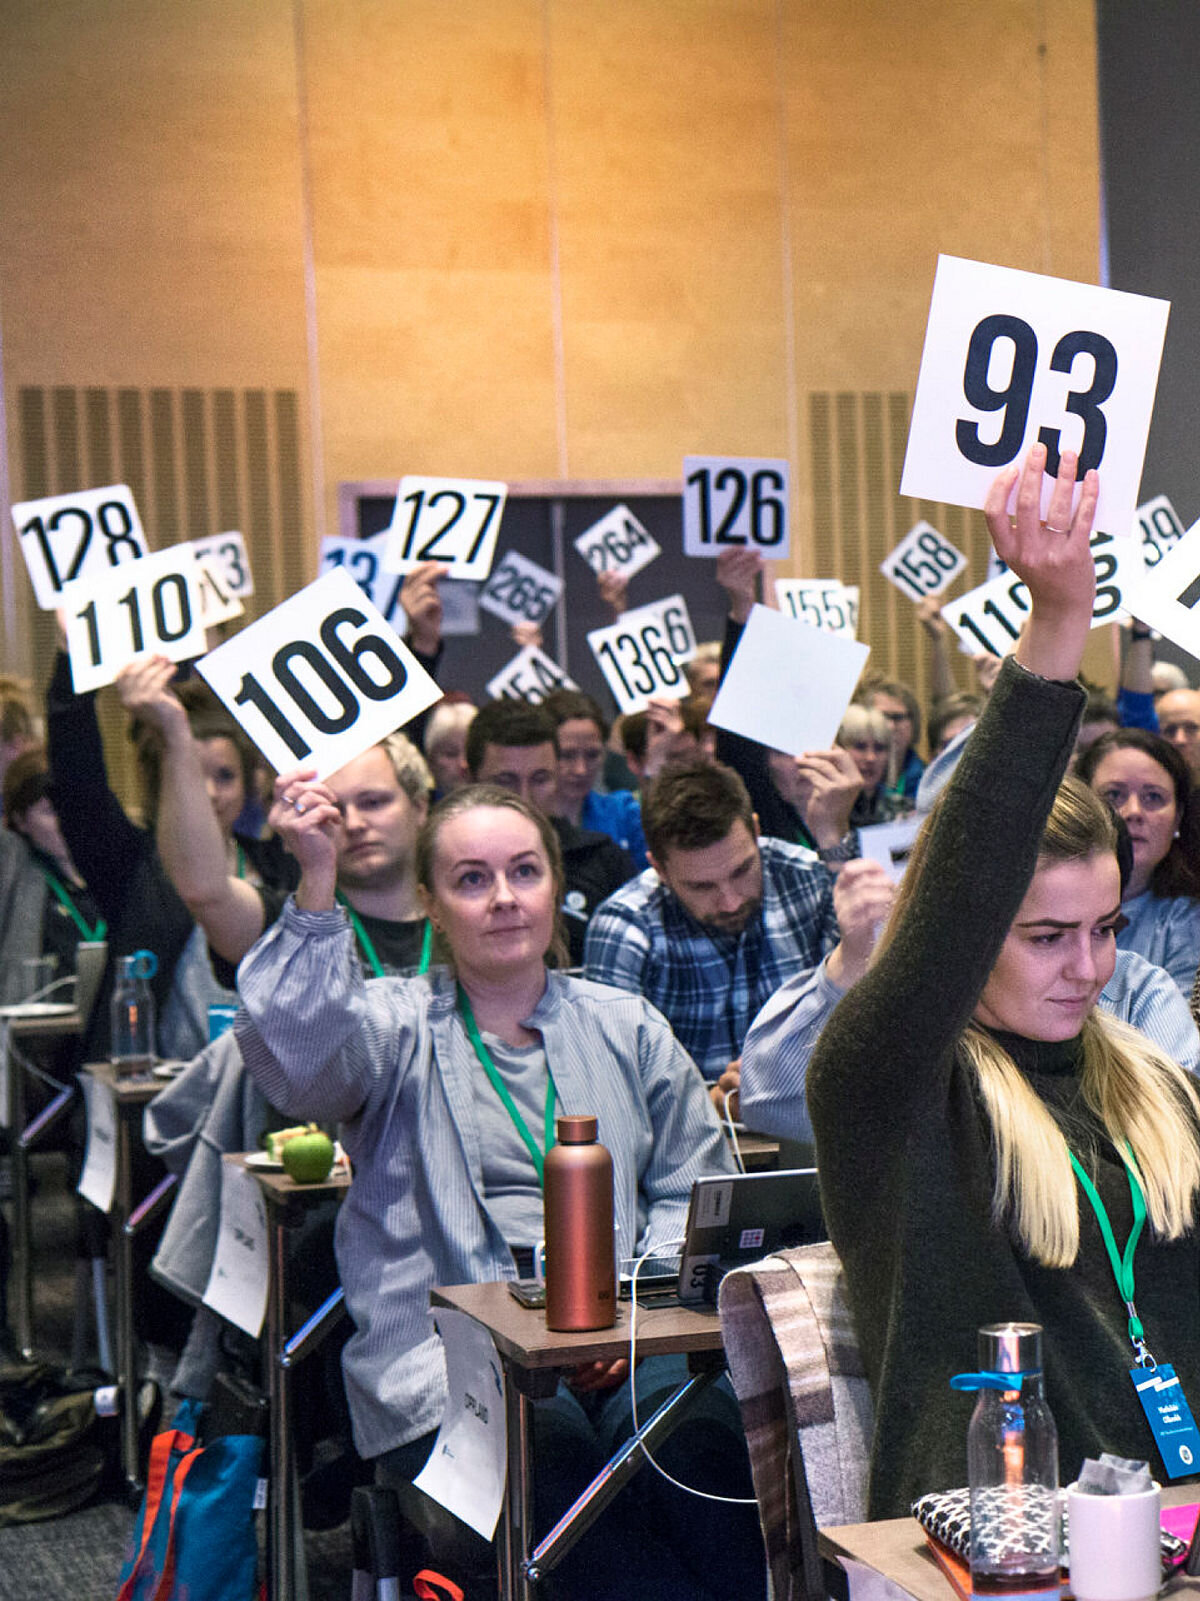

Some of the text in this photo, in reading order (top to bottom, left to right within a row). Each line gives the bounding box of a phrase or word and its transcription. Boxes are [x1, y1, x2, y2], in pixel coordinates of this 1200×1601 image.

[955, 313, 1119, 483] 93
[402, 490, 501, 564] 127
[687, 467, 785, 546] 126
[1139, 507, 1182, 567] 39
[21, 501, 142, 592] 128
[587, 519, 647, 571] 264
[893, 533, 958, 596] 158
[76, 573, 193, 667] 110
[786, 589, 845, 630] 155
[234, 607, 408, 760] 106
[501, 657, 562, 701] 54
[600, 626, 680, 700] 136
[690, 1264, 709, 1289] 03
